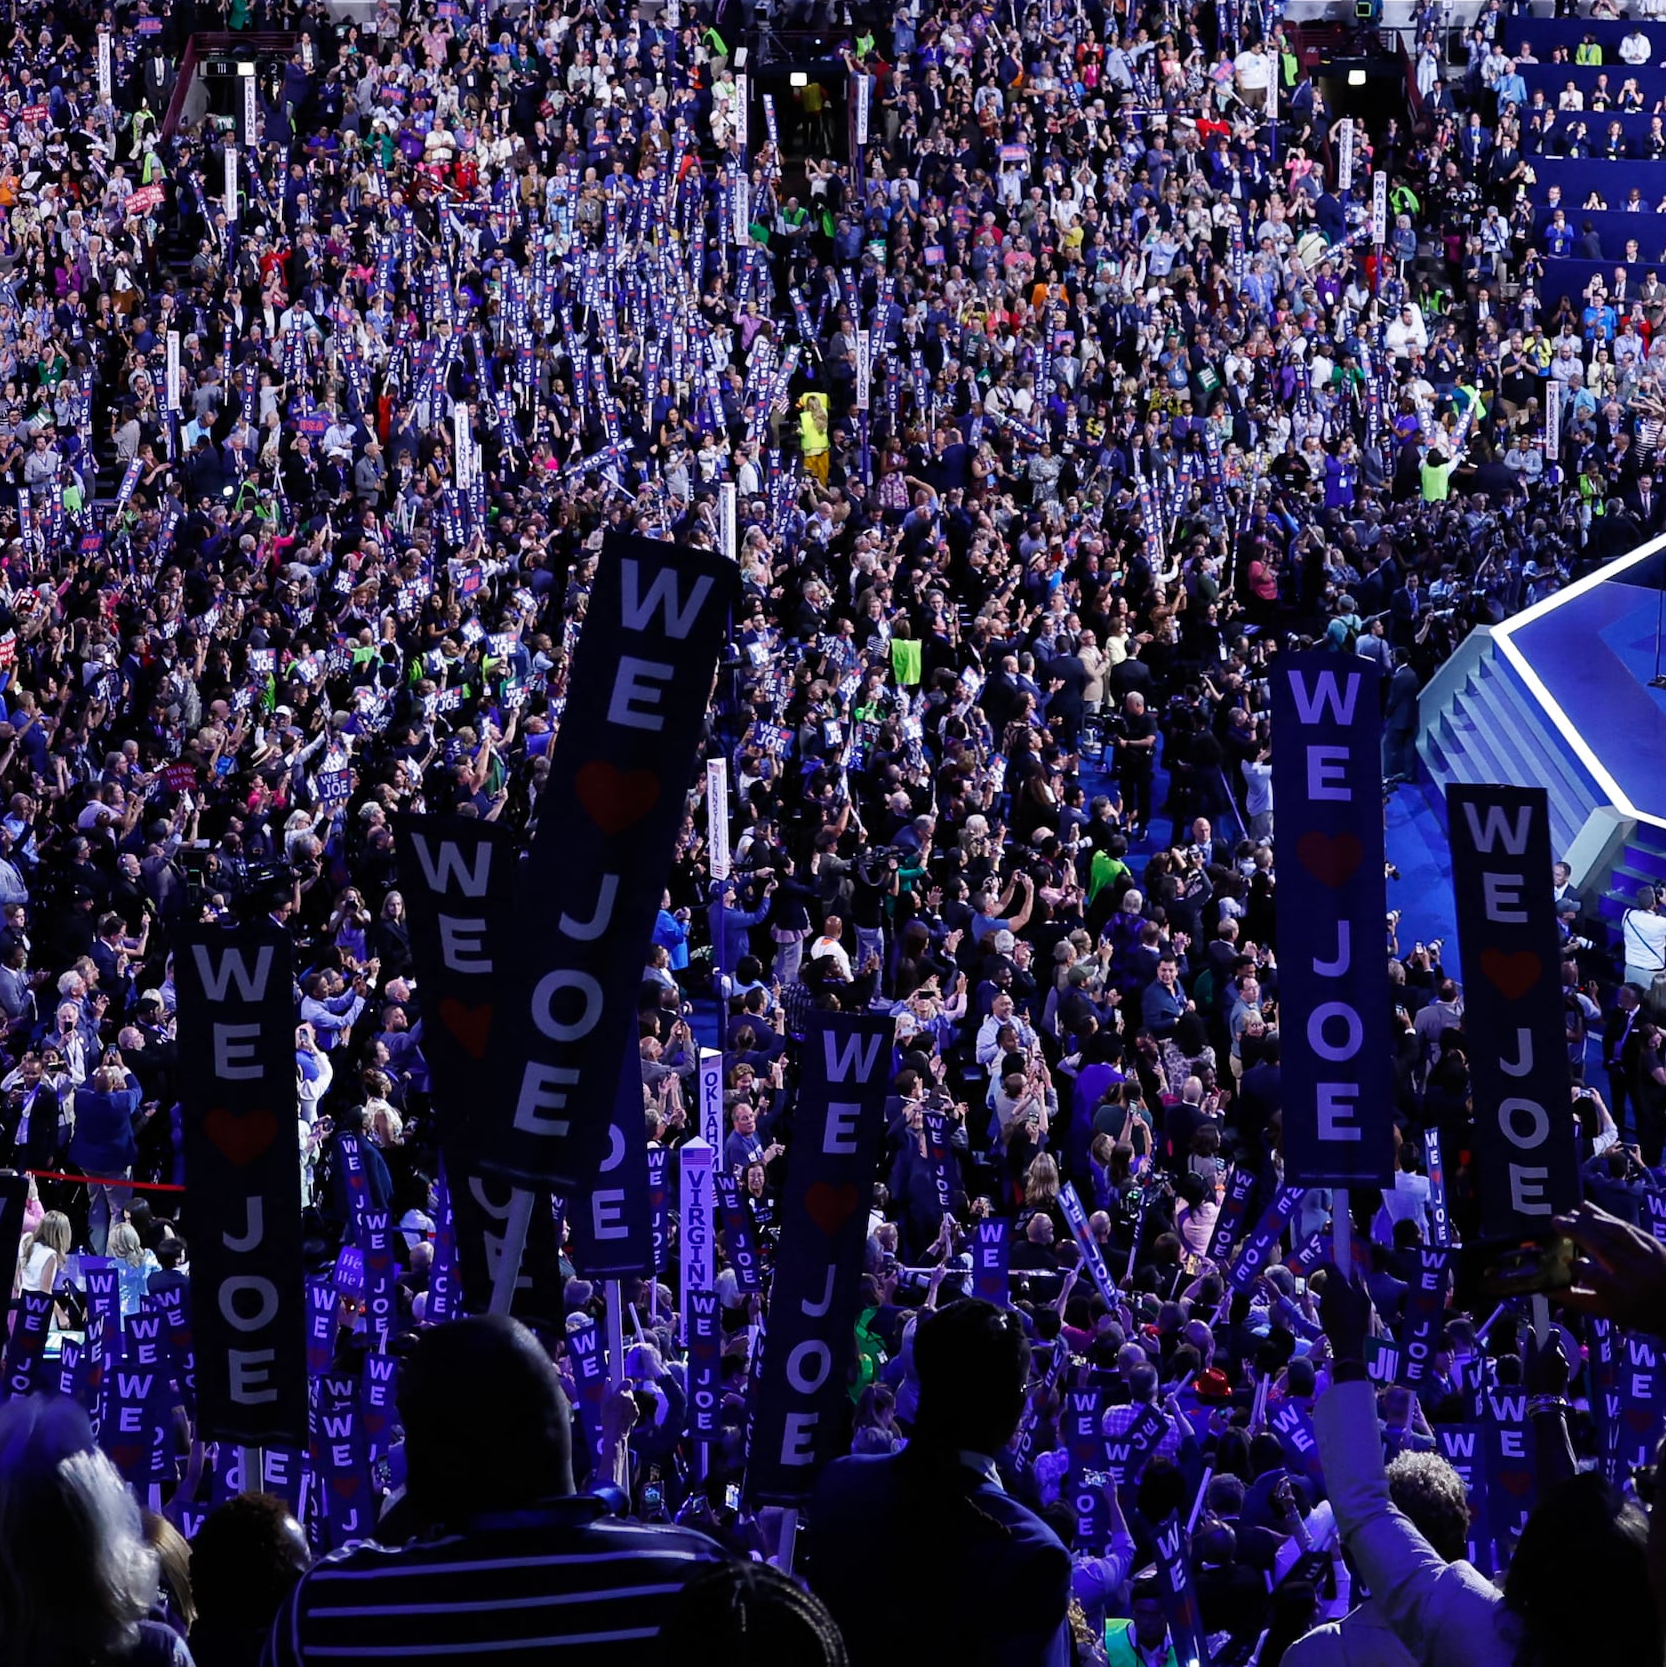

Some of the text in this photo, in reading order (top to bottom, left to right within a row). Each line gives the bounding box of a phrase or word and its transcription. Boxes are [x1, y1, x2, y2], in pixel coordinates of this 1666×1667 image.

[1375, 180, 1383, 234] MAINE
[514, 557, 715, 1137] WE JOE
[1287, 670, 1364, 1143] WE JOE
[1462, 804, 1551, 1217] WE JOE
[190, 944, 279, 1407] WE JOE
[782, 1031, 882, 1467] WE JOE
